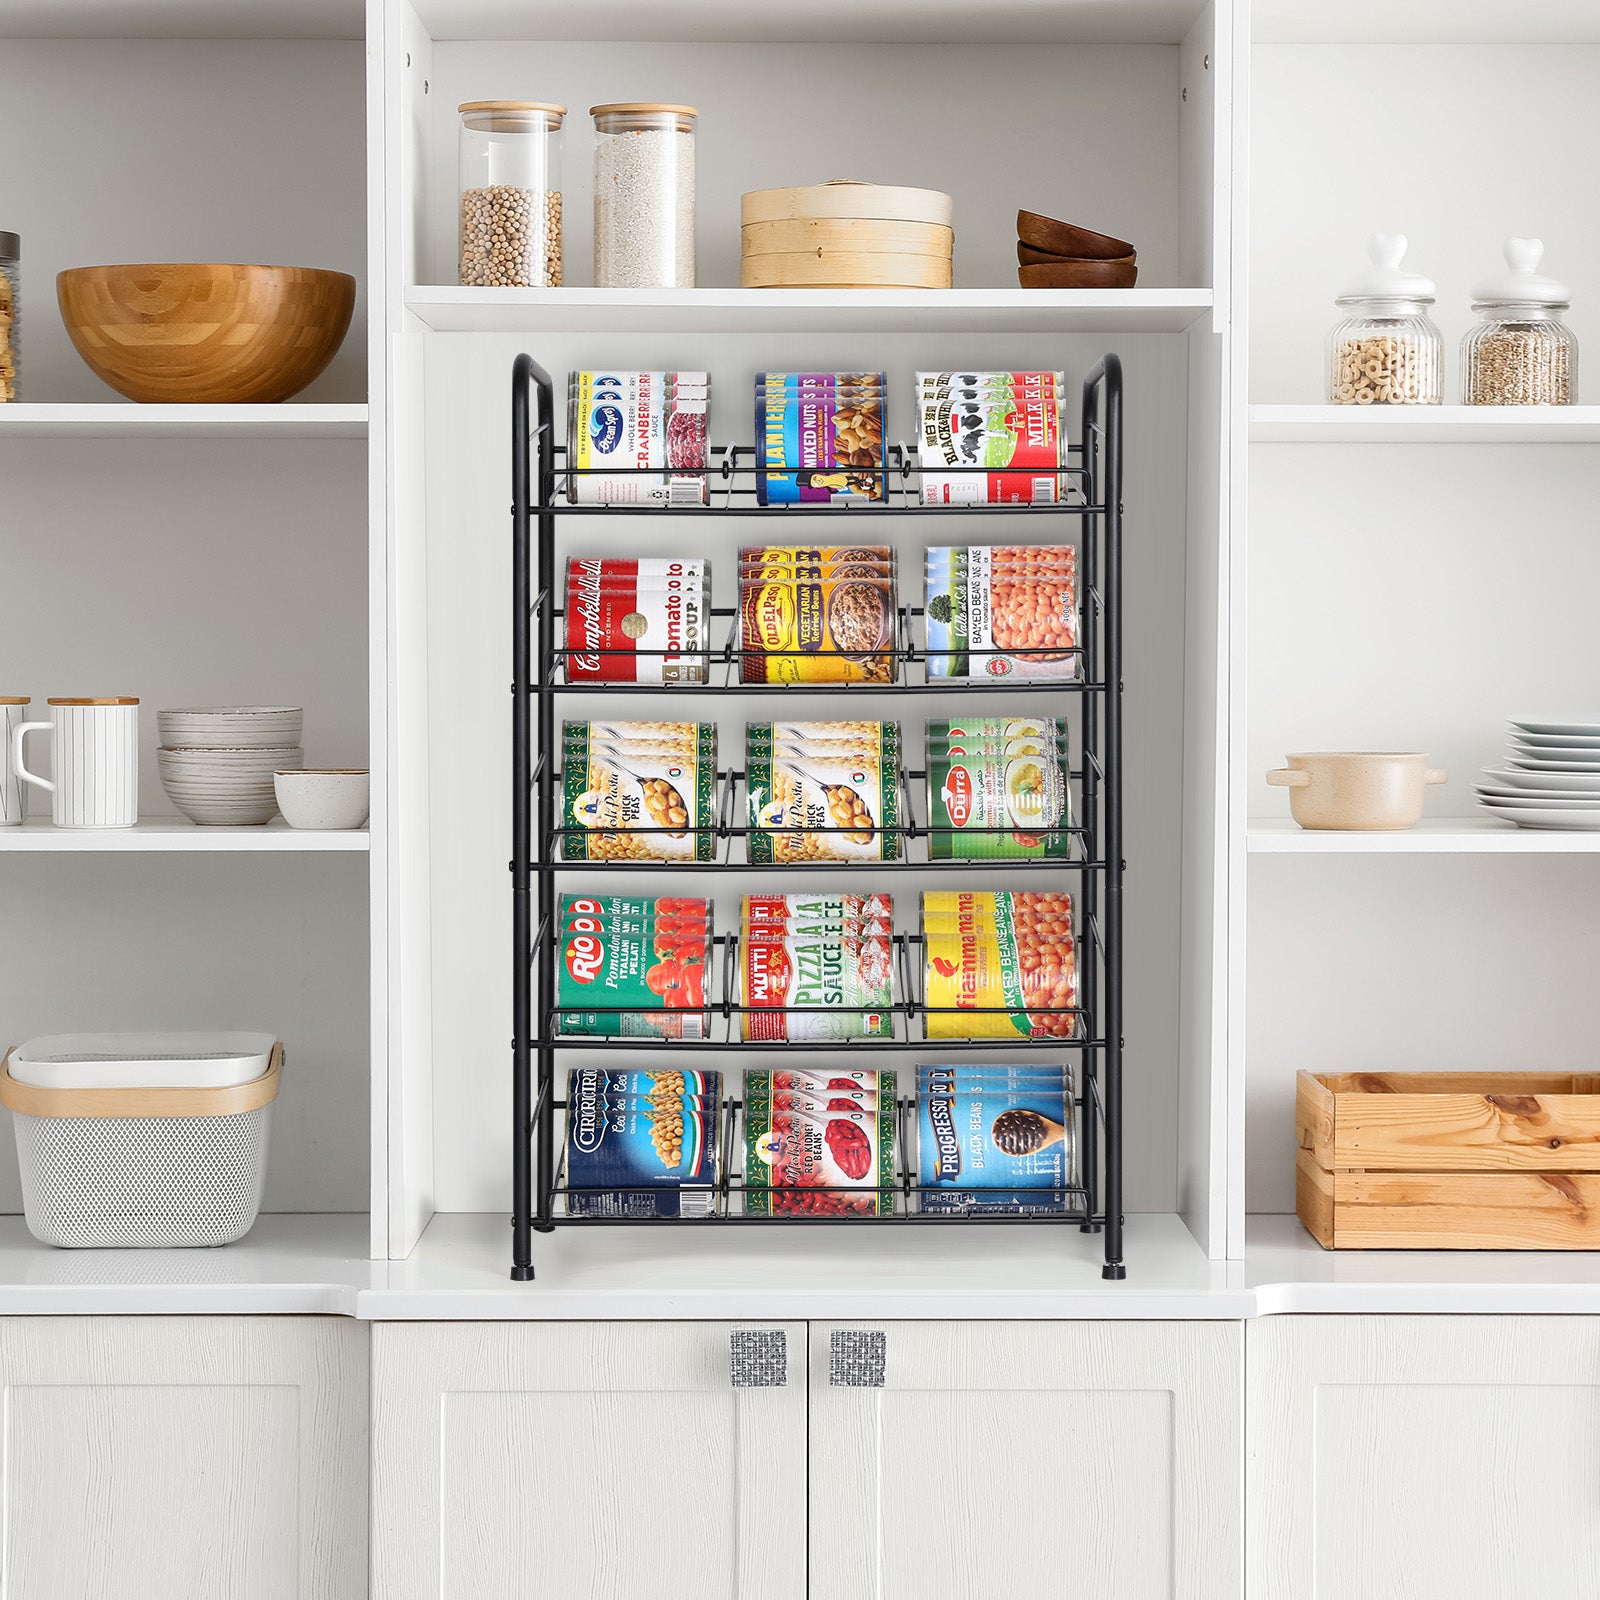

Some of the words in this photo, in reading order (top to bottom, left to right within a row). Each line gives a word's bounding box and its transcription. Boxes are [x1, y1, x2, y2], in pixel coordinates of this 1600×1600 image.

[803, 404, 816, 428] NUTS
[1027, 403, 1044, 448] MILK
[600, 426, 616, 450] Ocean
[804, 430, 816, 468] MIXED
[812, 590, 820, 608] Beans
[972, 581, 982, 606] BEANS
[664, 594, 681, 662] Tomato
[686, 602, 698, 650] SOUP
[801, 586, 810, 645] VEGETARIAN
[812, 610, 820, 642] Refried
[954, 611, 968, 637] Valle
[972, 608, 982, 644] BAKED
[766, 623, 780, 645] OLD
[622, 794, 631, 822] CHICK
[631, 796, 640, 820] PEAS
[954, 770, 966, 819] Durra
[606, 934, 620, 990] Pomodori
[620, 939, 630, 979] ITALIANI
[630, 942, 639, 974] PELATI
[754, 948, 768, 1000] MUTTI
[794, 944, 822, 1005] PIZZA
[824, 943, 842, 1004] SAUCE
[956, 935, 976, 1008] fiamma
[970, 1102, 983, 1131] BEANS
[804, 1124, 813, 1152] KIDNEY
[814, 1132, 822, 1160] BEANS
[932, 1099, 958, 1173] PROGRESSO
[970, 1135, 984, 1168] BLACK
[804, 1156, 813, 1174] RED
